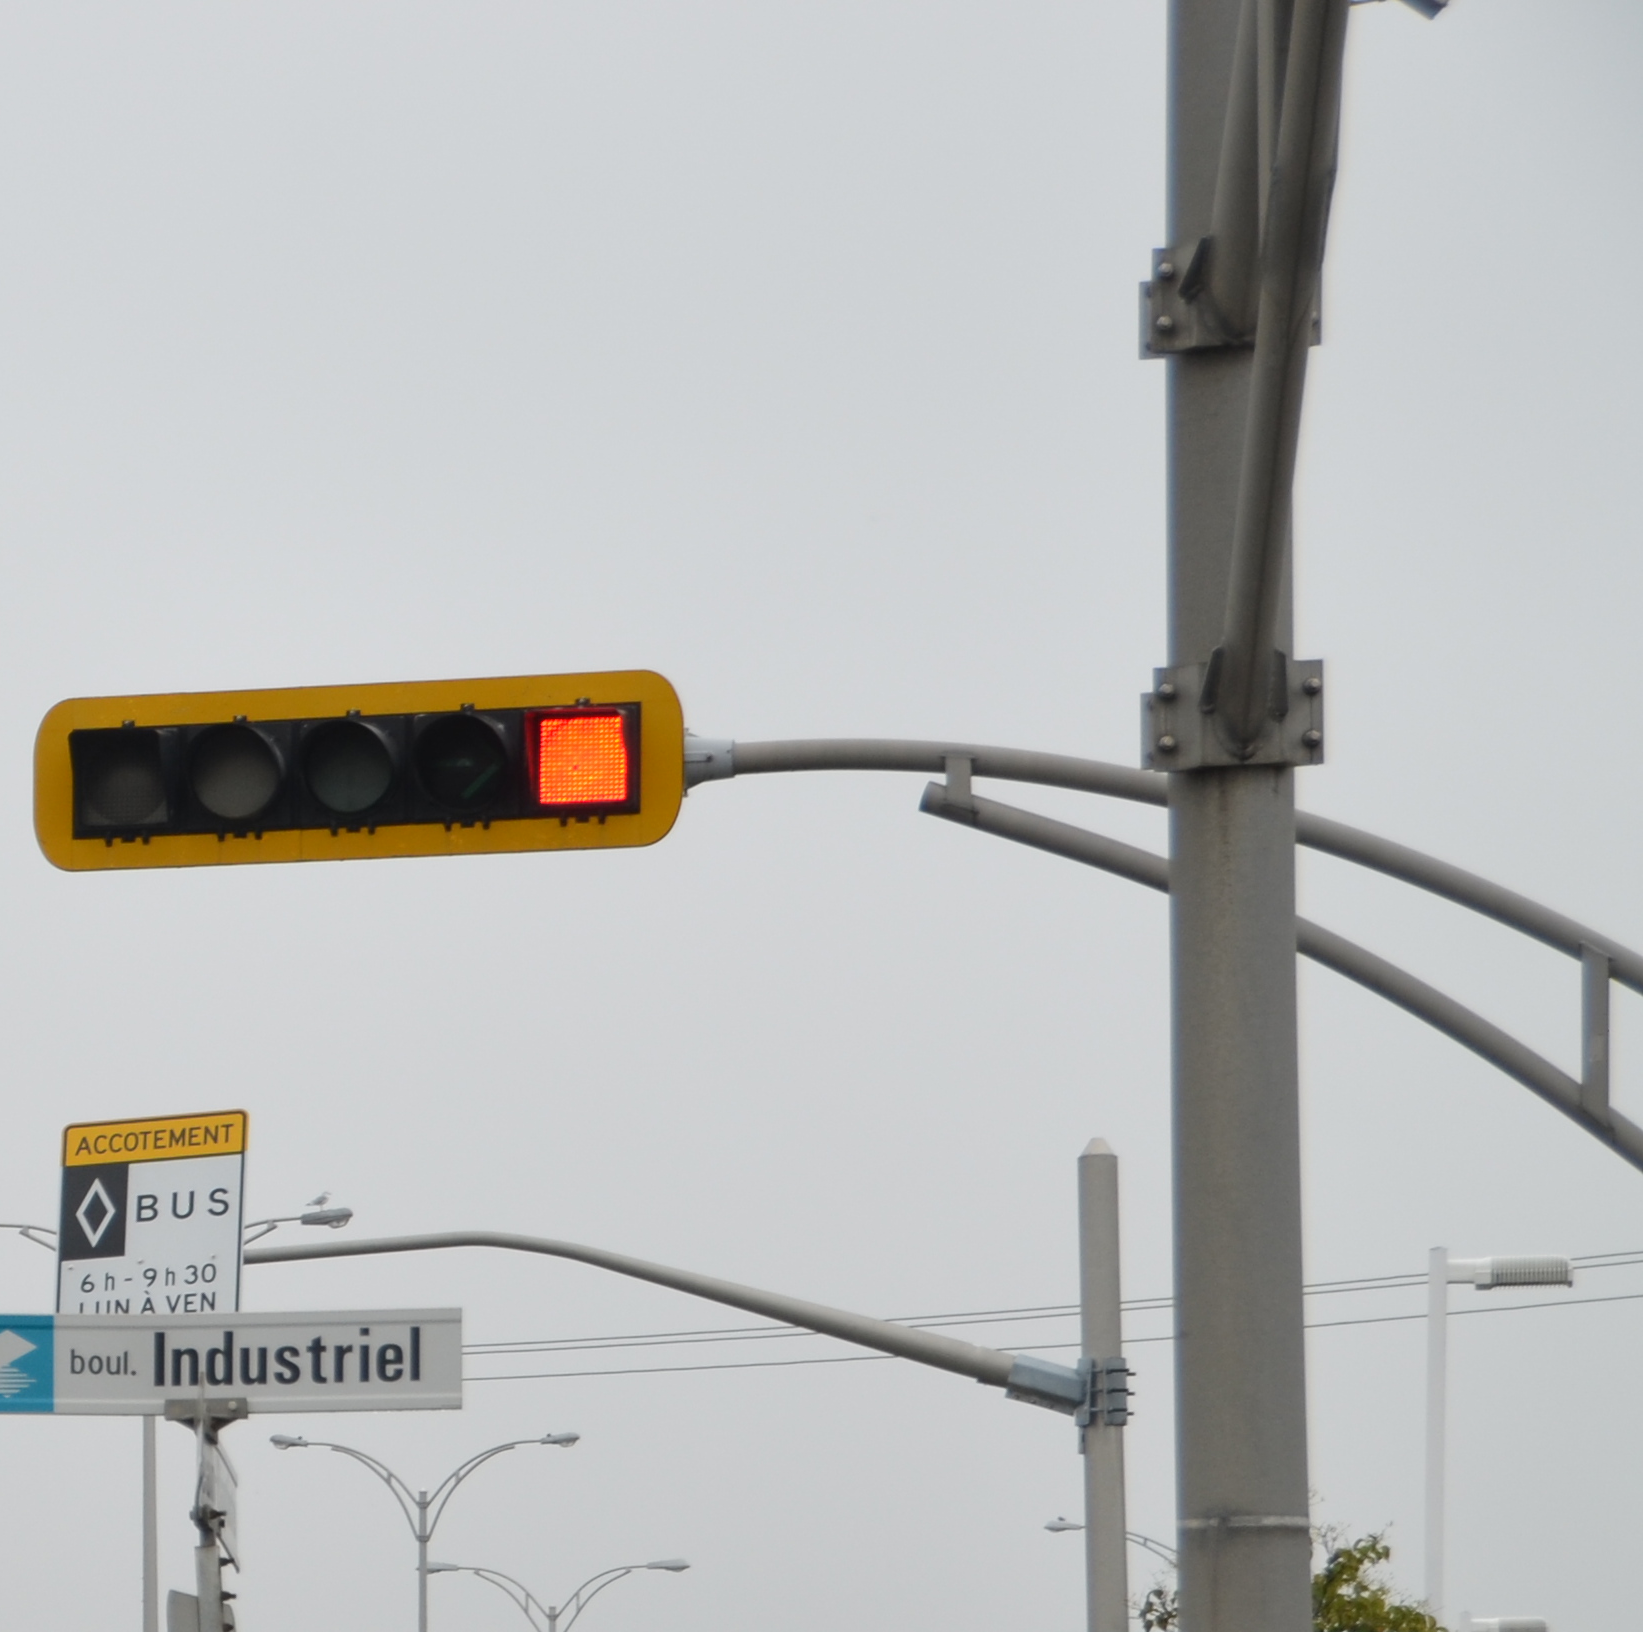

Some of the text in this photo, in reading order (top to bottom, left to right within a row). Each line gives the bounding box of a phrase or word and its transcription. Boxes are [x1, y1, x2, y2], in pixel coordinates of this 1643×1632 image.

[75, 1124, 234, 1156] ACCOTEMENT
[136, 1188, 229, 1222] BUS
[165, 1291, 217, 1313] VEN
[70, 1326, 421, 1387] boul. Industriel
